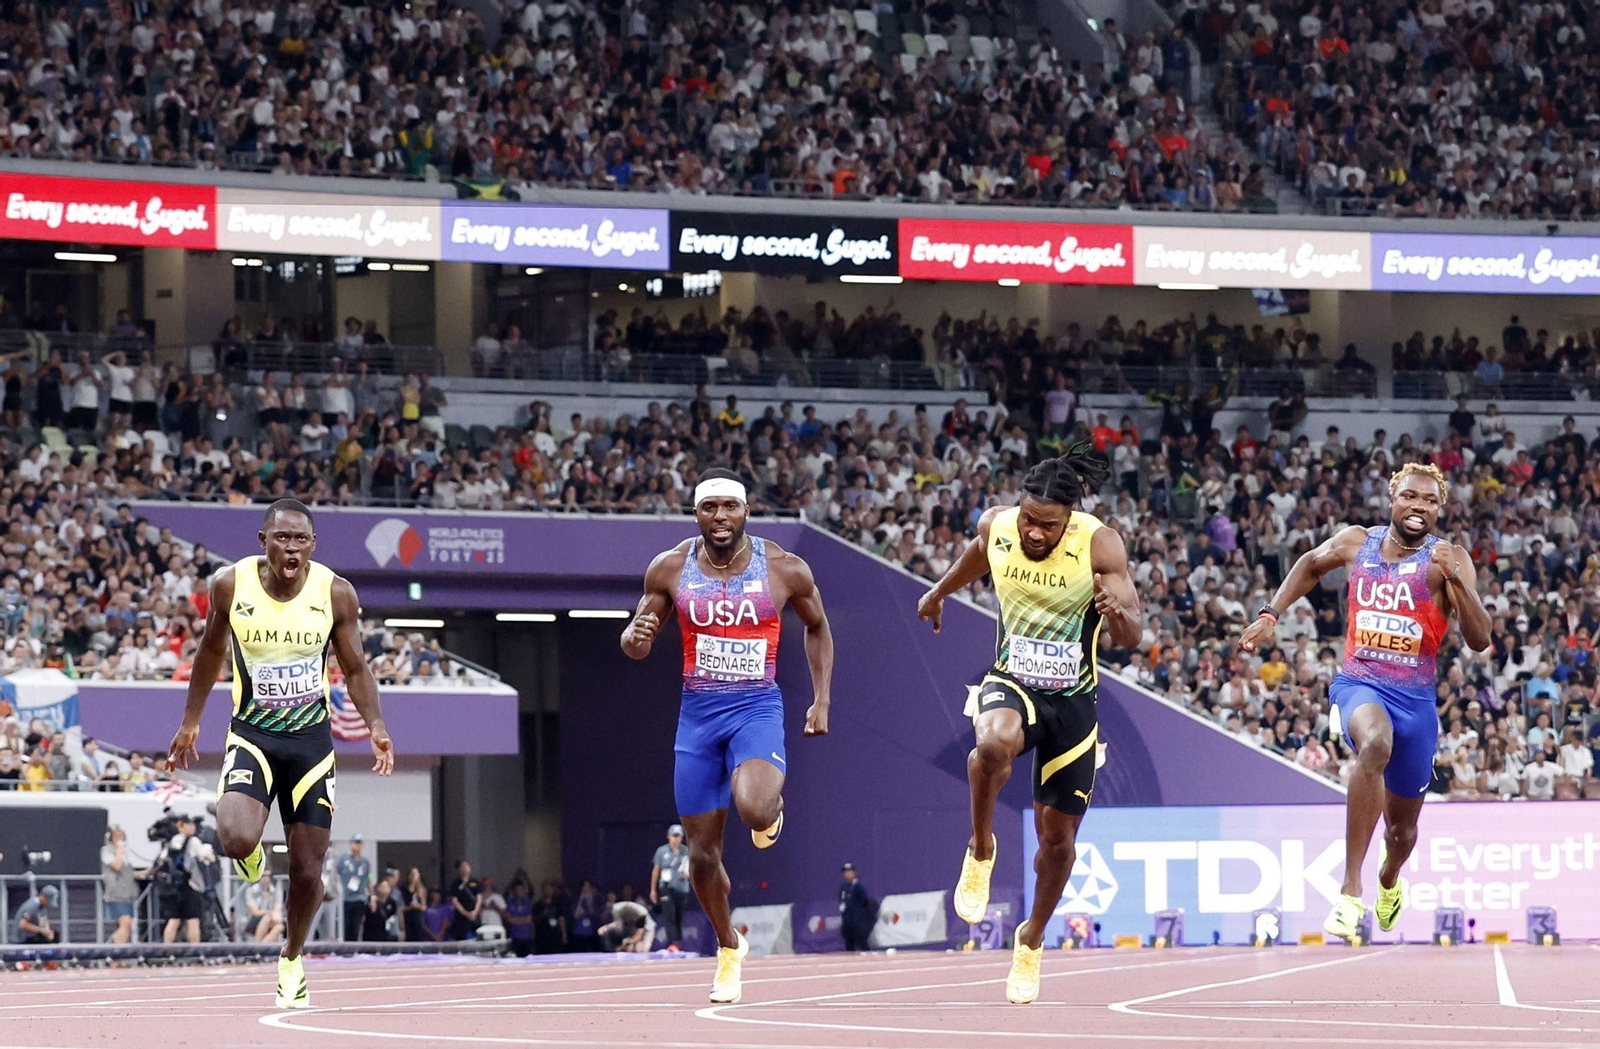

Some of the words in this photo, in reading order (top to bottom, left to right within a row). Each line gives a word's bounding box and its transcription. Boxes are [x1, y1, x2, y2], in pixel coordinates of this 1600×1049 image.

[7, 193, 62, 228] Every
[66, 201, 138, 228] second,
[140, 197, 208, 235] Sugoi.
[227, 206, 286, 241] Every
[288, 213, 363, 242] second,
[362, 209, 432, 246] Sugoi.
[451, 217, 510, 251] Every
[513, 223, 590, 251] second,
[591, 219, 660, 256] Sugoi.
[679, 228, 738, 260] Every
[741, 233, 819, 258] second,
[821, 229, 891, 265] Sugoi.
[910, 236, 970, 268] Every
[973, 241, 1052, 266] second,
[1053, 237, 1125, 272] Sugoi.
[1145, 243, 1205, 276] Every
[1208, 247, 1288, 273] second,
[1289, 243, 1362, 278] Sugoi.
[1382, 249, 1444, 281] Every
[1447, 253, 1526, 279] second,
[1003, 565, 1067, 588] JAMAICA
[1356, 577, 1415, 610] USA
[689, 599, 759, 627] USA
[1372, 614, 1417, 636] TDK
[243, 629, 323, 645] JAMAICA
[716, 640, 761, 655] TDK
[1027, 640, 1076, 658] TDK
[272, 659, 318, 679] TDK
[699, 652, 762, 673] BEDNAREK
[1012, 655, 1077, 676] THOMPSON
[257, 673, 320, 696] SEVILLE
[1113, 839, 1347, 914] TDK
[979, 920, 994, 942] 9
[1157, 916, 1177, 940] 7
[1441, 913, 1458, 934] 4
[1532, 913, 1550, 935] 3
